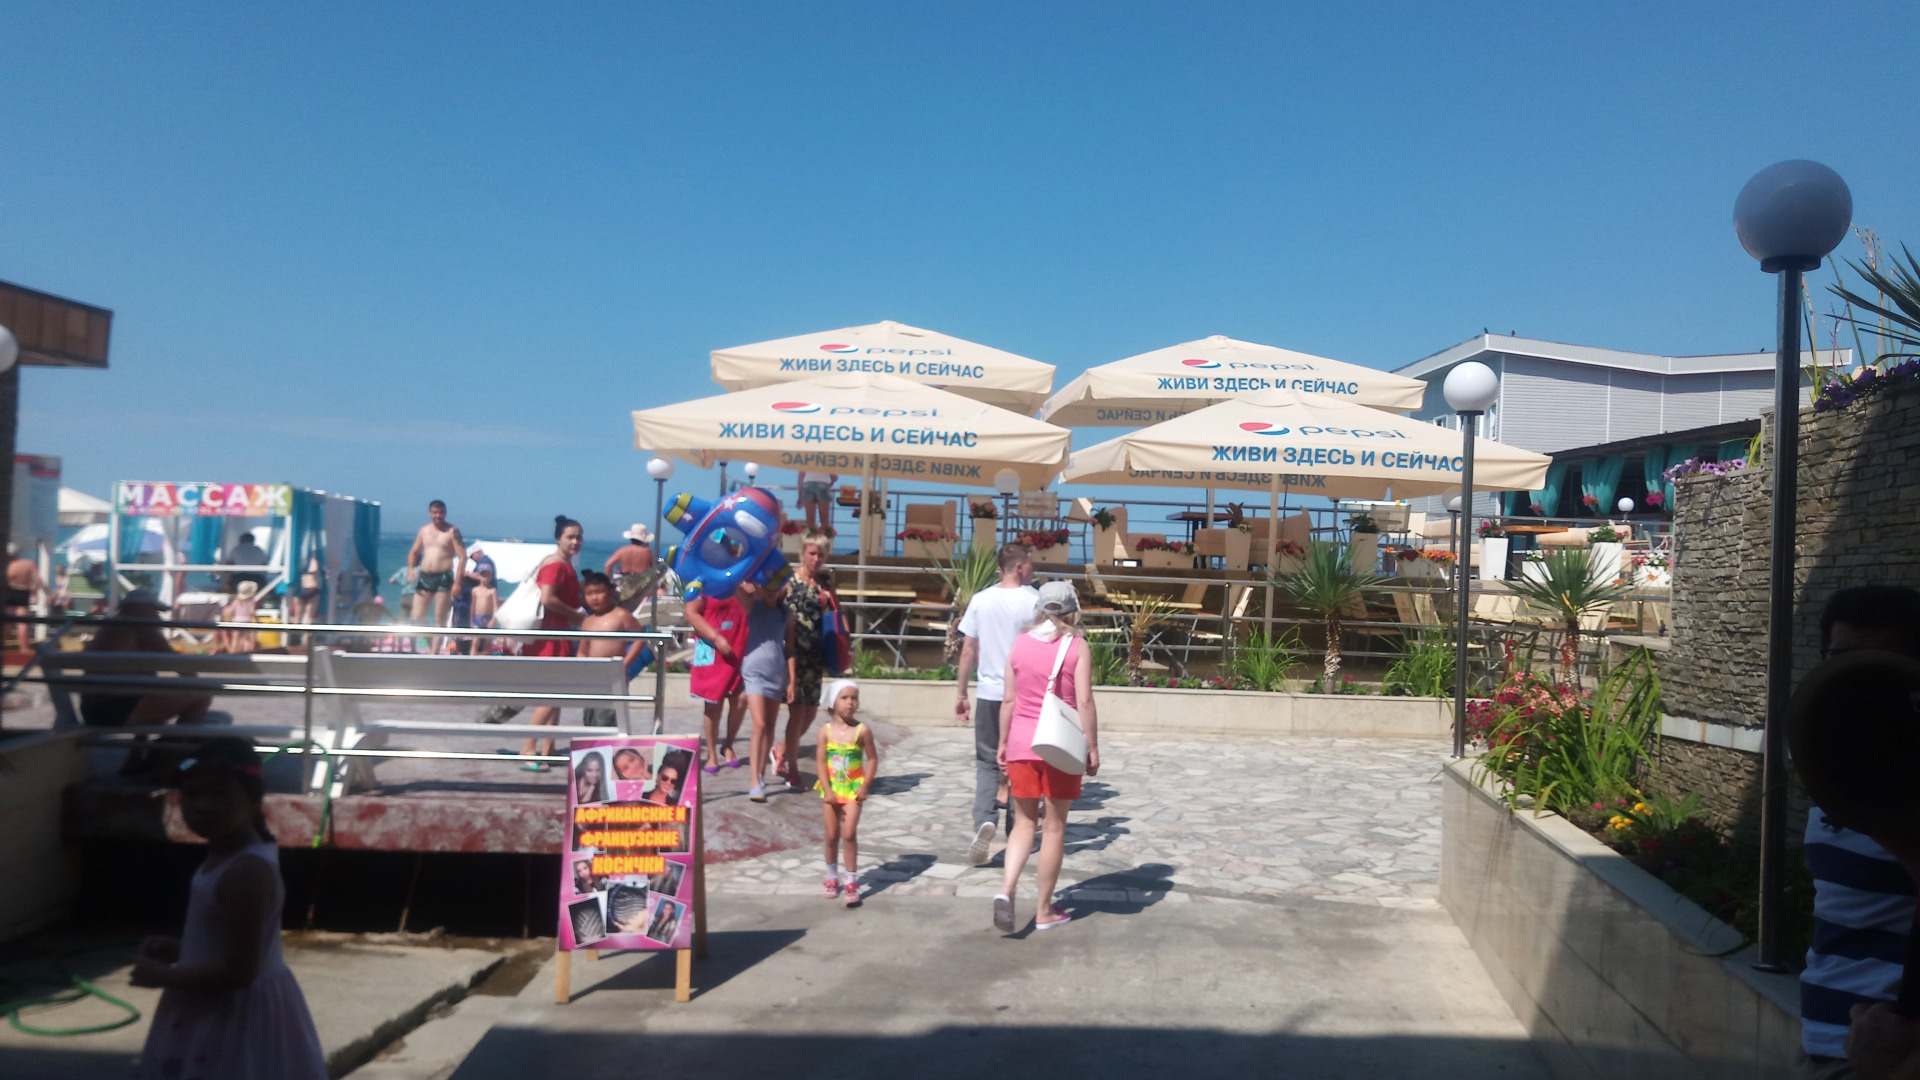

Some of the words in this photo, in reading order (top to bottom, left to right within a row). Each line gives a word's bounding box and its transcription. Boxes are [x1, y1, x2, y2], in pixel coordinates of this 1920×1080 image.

[866, 347, 952, 356] pepsi
[779, 358, 832, 371] ЖИВИ
[836, 359, 895, 373] ЗДЕСЬ
[899, 361, 911, 374] И
[915, 362, 985, 379] СЕЙЧАС
[1229, 362, 1315, 371] pepsi
[1157, 377, 1209, 390] ЖИВИ
[1213, 377, 1271, 392] ЗДЕСЬ
[1275, 379, 1287, 389] И
[1291, 378, 1359, 395] СЕЙЧАС
[830, 406, 938, 418] pepsi
[719, 422, 785, 439] ЖИВИ
[791, 423, 865, 443] ЗДЕСЬ
[870, 426, 885, 443] И
[891, 427, 979, 448] СЕЙЧАС
[1299, 425, 1407, 439] pepsi
[1212, 445, 1277, 462] ЖИВИ
[1283, 446, 1356, 467] ЗДЕСЬ
[1361, 450, 1375, 466] И
[1381, 450, 1464, 472] СЕЙЧАС
[118, 484, 290, 507] МАССАЖ
[574, 806, 675, 823] АФРИКАНСКИЕ
[676, 806, 686, 822] И
[580, 831, 679, 849] ФРАНЦУЗСКИЕ
[592, 855, 665, 874] КОСИЧКИ
